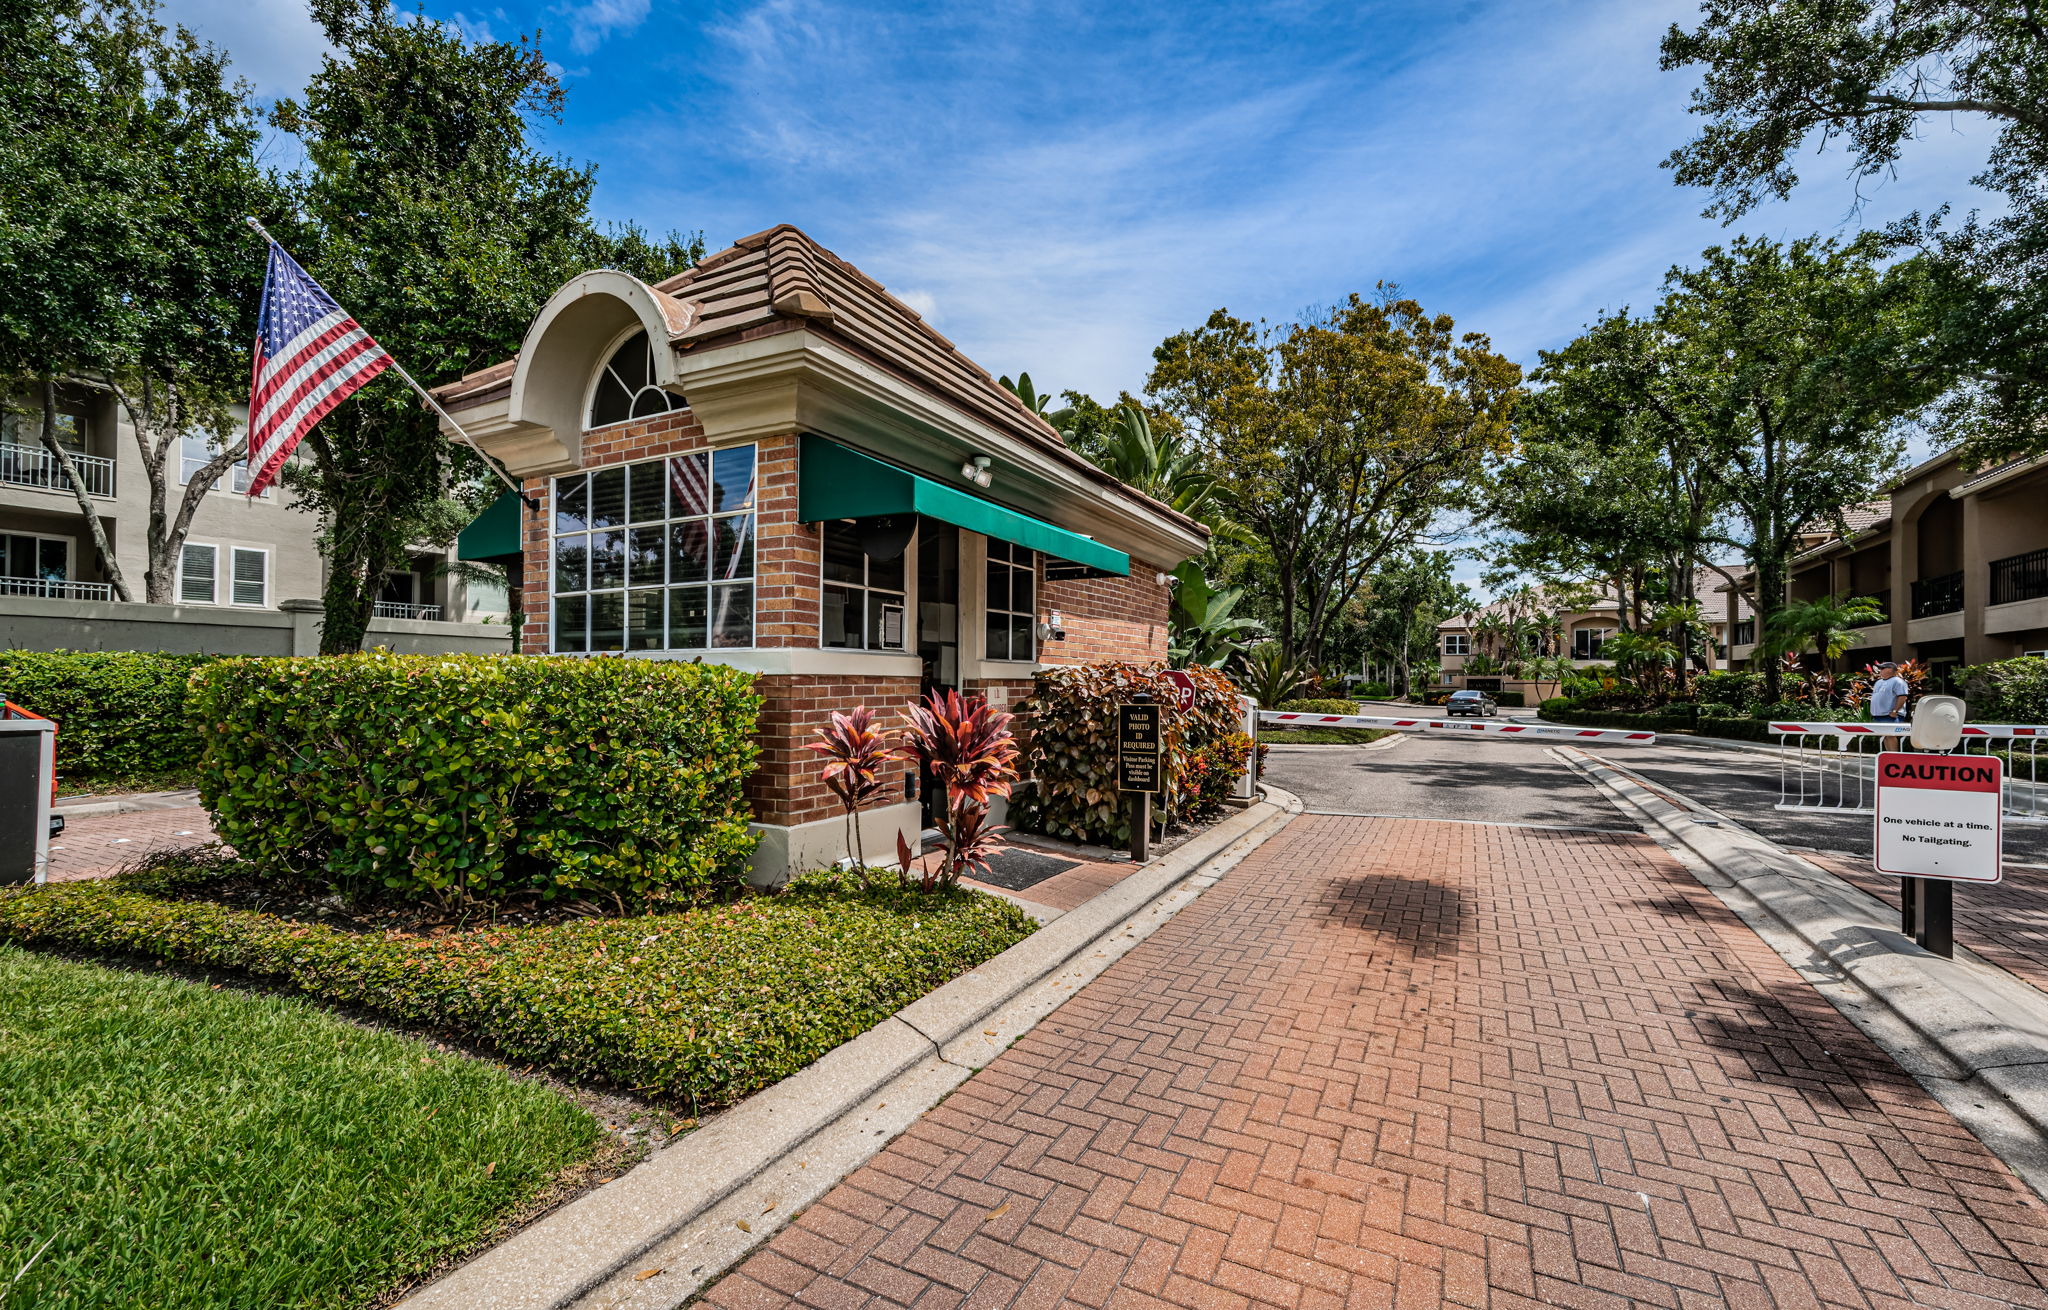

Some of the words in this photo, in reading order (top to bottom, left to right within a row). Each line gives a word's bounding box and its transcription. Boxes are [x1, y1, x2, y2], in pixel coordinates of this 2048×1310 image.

[1135, 732, 1143, 740] ID
[1123, 741, 1156, 750] REQUIRED
[1884, 763, 1993, 783] CAUTION
[1883, 816, 1903, 825] One
[1905, 819, 1941, 828] vehicle
[1943, 821, 1956, 829] at
[1966, 822, 1993, 831] time.
[1902, 834, 1917, 843] No
[1918, 836, 1973, 848] Tailgating.
